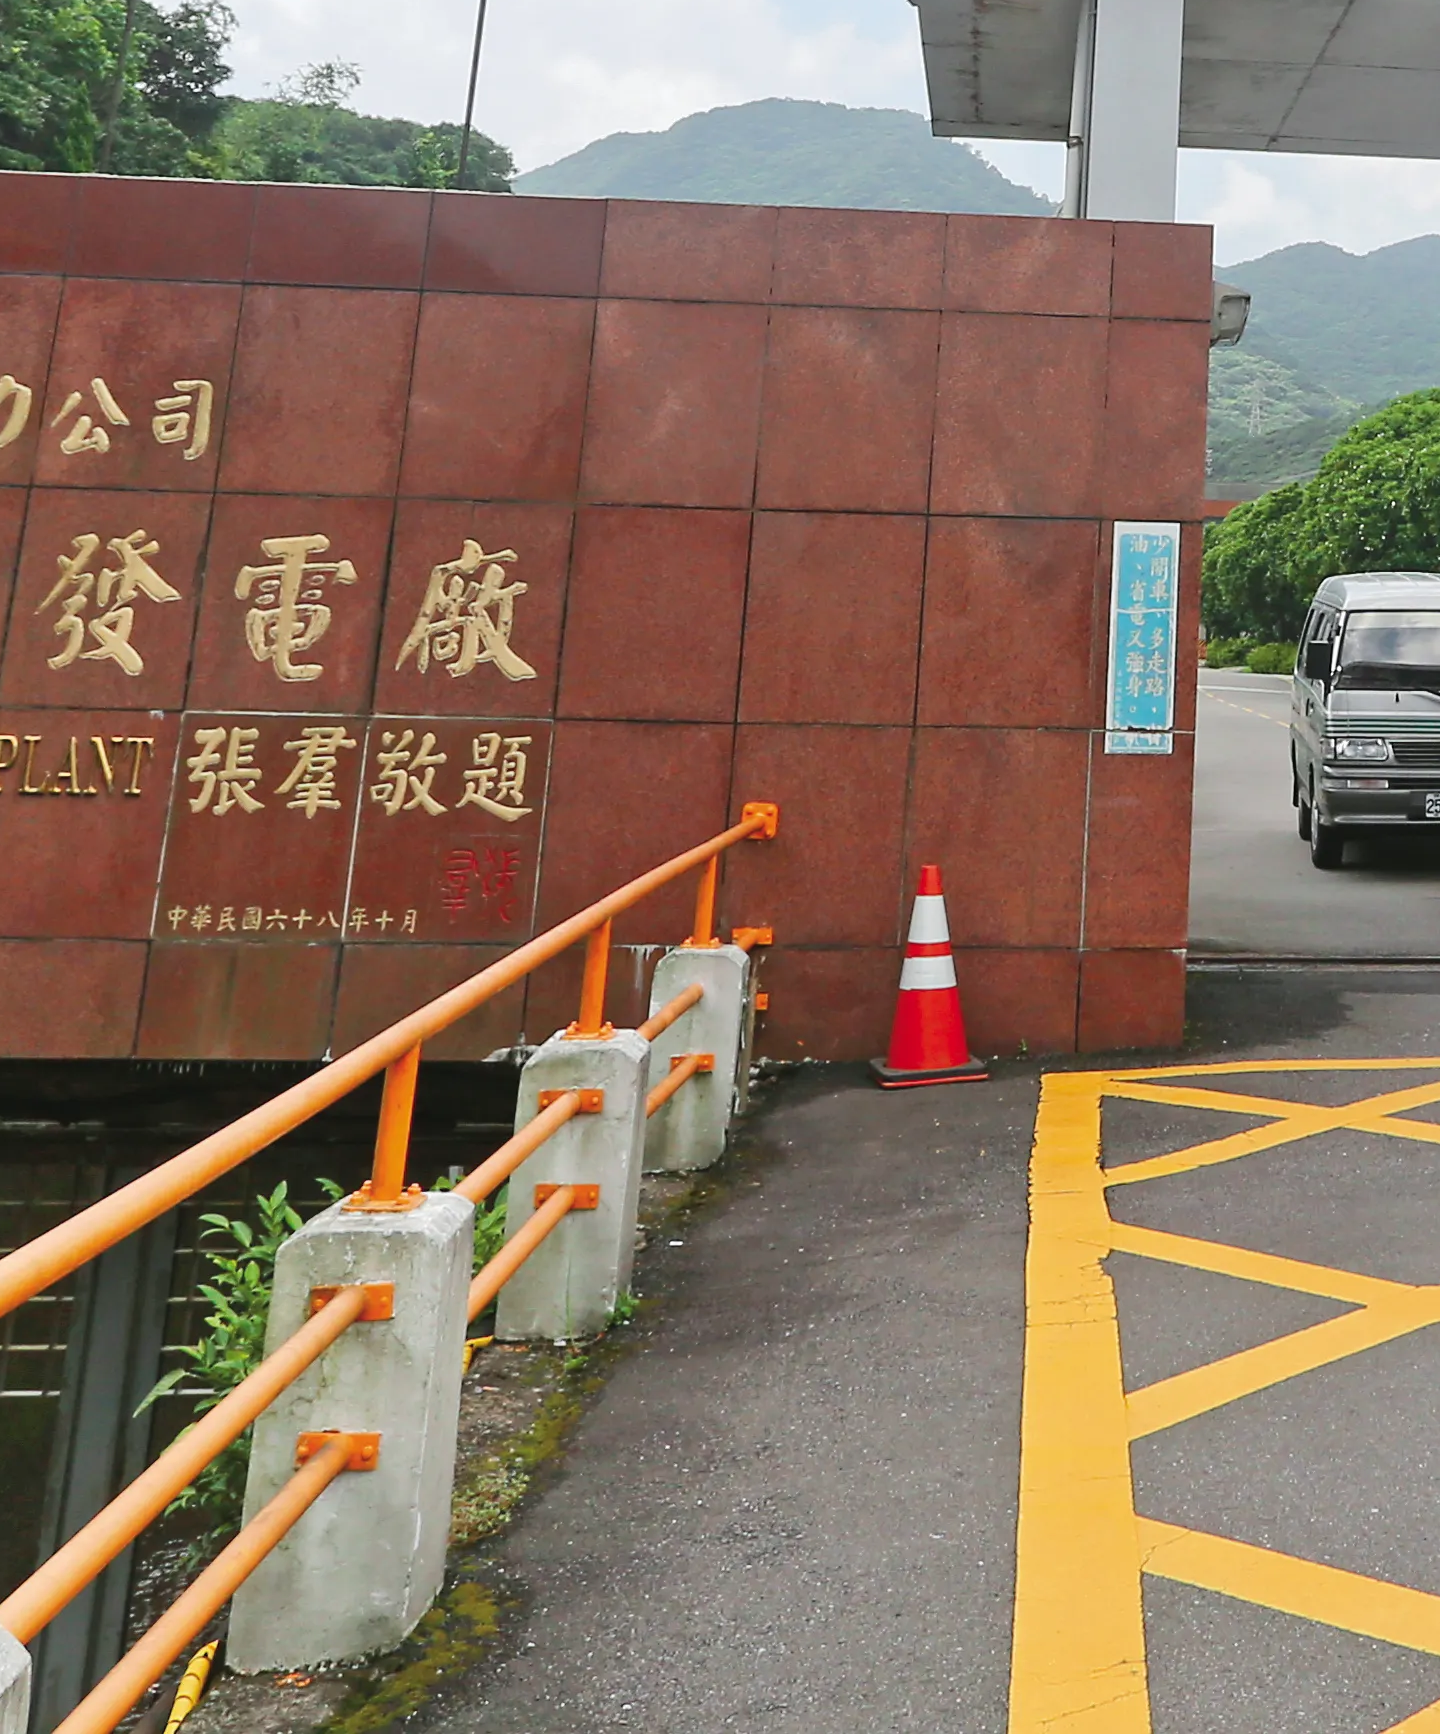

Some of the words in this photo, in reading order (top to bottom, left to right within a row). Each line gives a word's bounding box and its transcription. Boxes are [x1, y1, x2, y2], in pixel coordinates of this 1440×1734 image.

[167, 904, 418, 934] 中華民國六十八年十月
